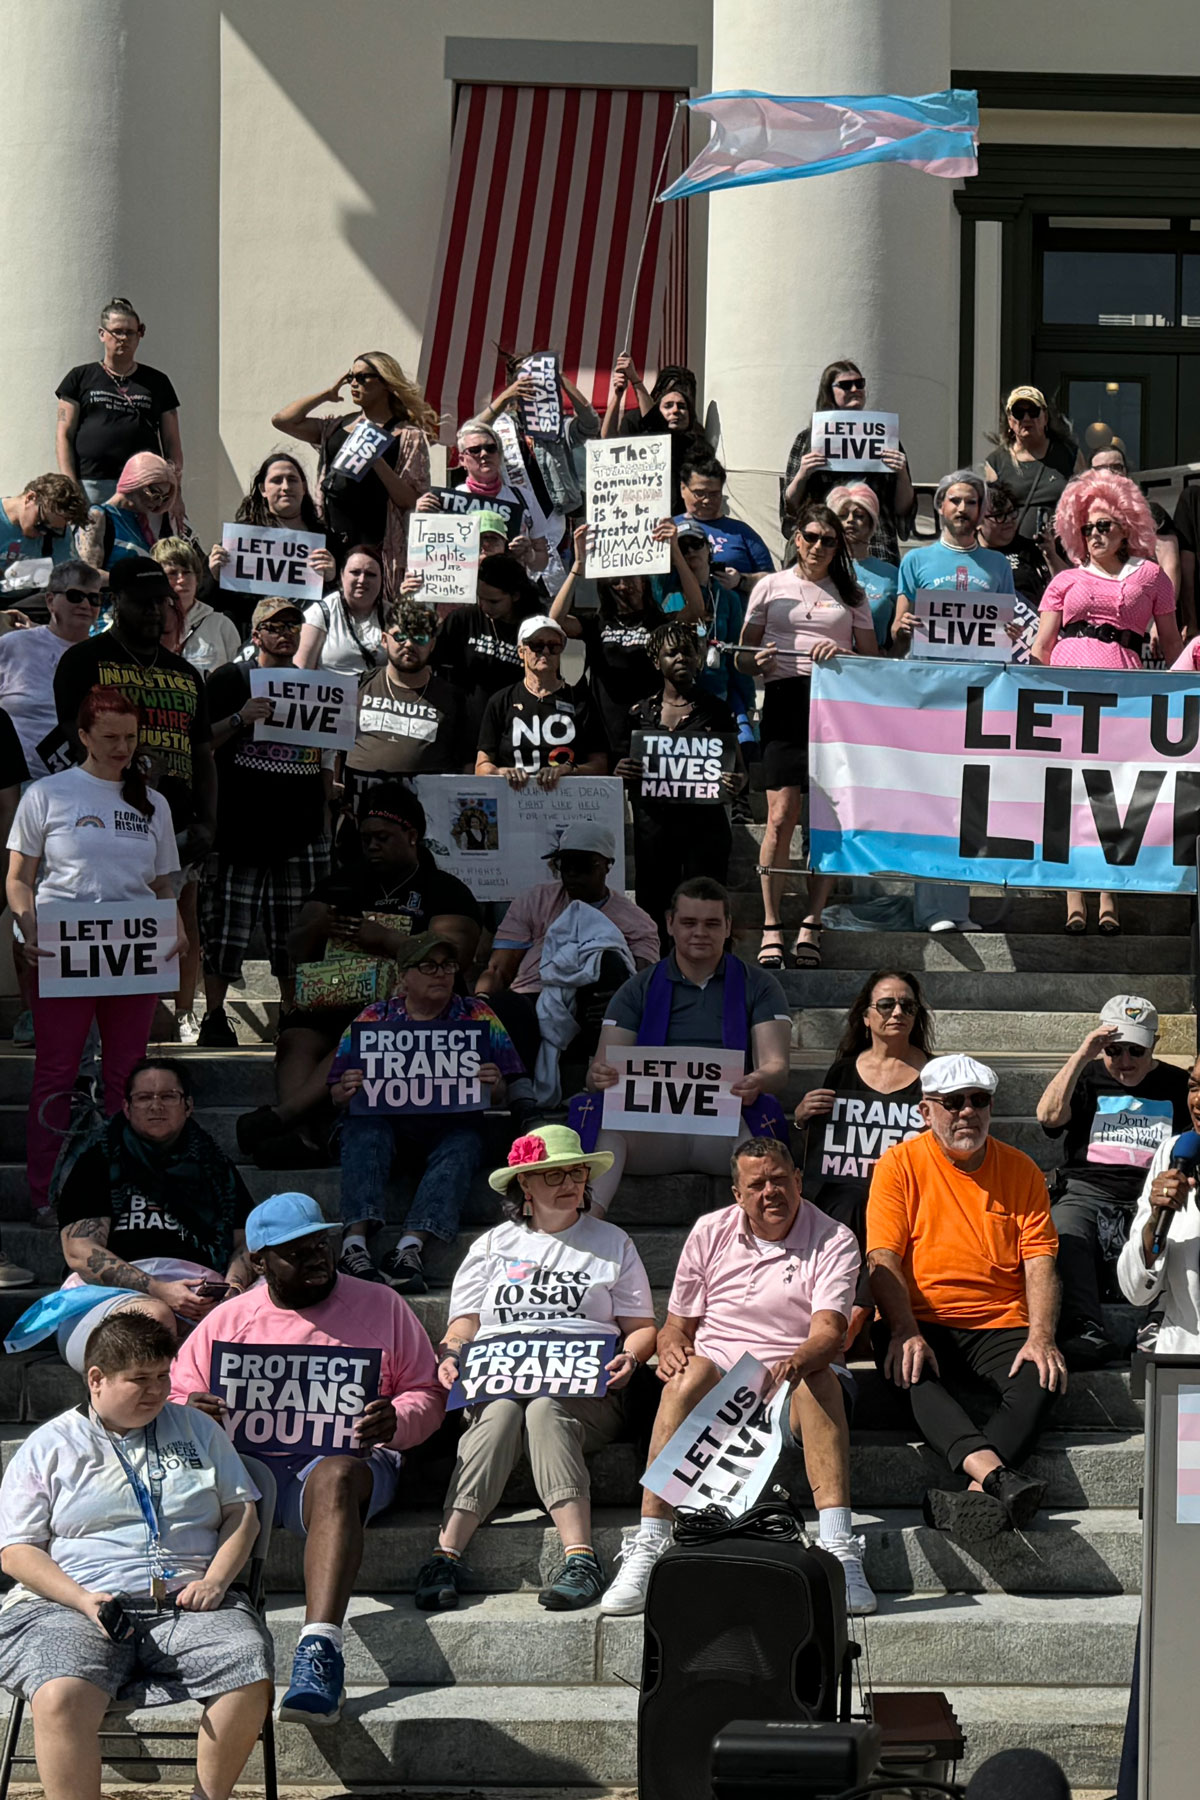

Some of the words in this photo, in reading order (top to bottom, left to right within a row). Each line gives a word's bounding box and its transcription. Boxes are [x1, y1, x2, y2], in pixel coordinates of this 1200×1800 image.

[532, 358, 552, 433] TRANS
[542, 357, 559, 435] PROTECT
[825, 422, 856, 435] LET
[863, 424, 885, 436] US
[610, 444, 647, 464] The
[825, 438, 885, 459] LIVE
[440, 492, 511, 523] TRANS
[592, 491, 618, 506] only
[594, 508, 606, 522] is
[613, 507, 628, 520] to
[635, 504, 649, 516] be
[594, 522, 639, 540] treated
[237, 537, 275, 554] LET
[283, 542, 309, 559] US
[425, 545, 466, 570] Rights
[235, 555, 307, 585] LIVE
[414, 570, 455, 583] Human
[424, 584, 465, 596] Rights
[930, 602, 966, 618] LET
[973, 604, 998, 619] US
[928, 620, 996, 646] LIVE
[99, 667, 199, 694] INJUSTICE
[268, 681, 310, 700] LET
[317, 685, 344, 704] US
[264, 700, 341, 734] LIVE
[362, 694, 437, 719] PEANUTS
[512, 713, 575, 747] NO
[963, 686, 1118, 754] LET
[643, 736, 723, 758] TRANS
[642, 756, 722, 781] LIVES
[578, 788, 610, 798] DEAD,
[641, 780, 719, 799] MATTER
[114, 820, 149, 834] RISING
[60, 920, 113, 941] LET
[124, 918, 158, 939] US
[61, 943, 158, 978] LIVE
[359, 1030, 482, 1051] PROTECT
[360, 1051, 481, 1078] TRANS
[626, 1060, 677, 1078] LET
[687, 1062, 722, 1081] US
[362, 1078, 481, 1107] YOUTH
[624, 1080, 719, 1117] LIVE
[832, 1098, 926, 1128] TRANS
[1118, 1113, 1149, 1128] Don't
[495, 1285, 524, 1305] to
[529, 1285, 589, 1311] say
[466, 1341, 605, 1362] PROTECT
[220, 1353, 370, 1384] PROTECT
[465, 1357, 600, 1379] TRANS
[220, 1378, 365, 1416] TRANS
[462, 1376, 598, 1400] YOUTH
[222, 1410, 363, 1449] YOUTH
[673, 1425, 722, 1487] LET
[716, 1386, 757, 1426] US
